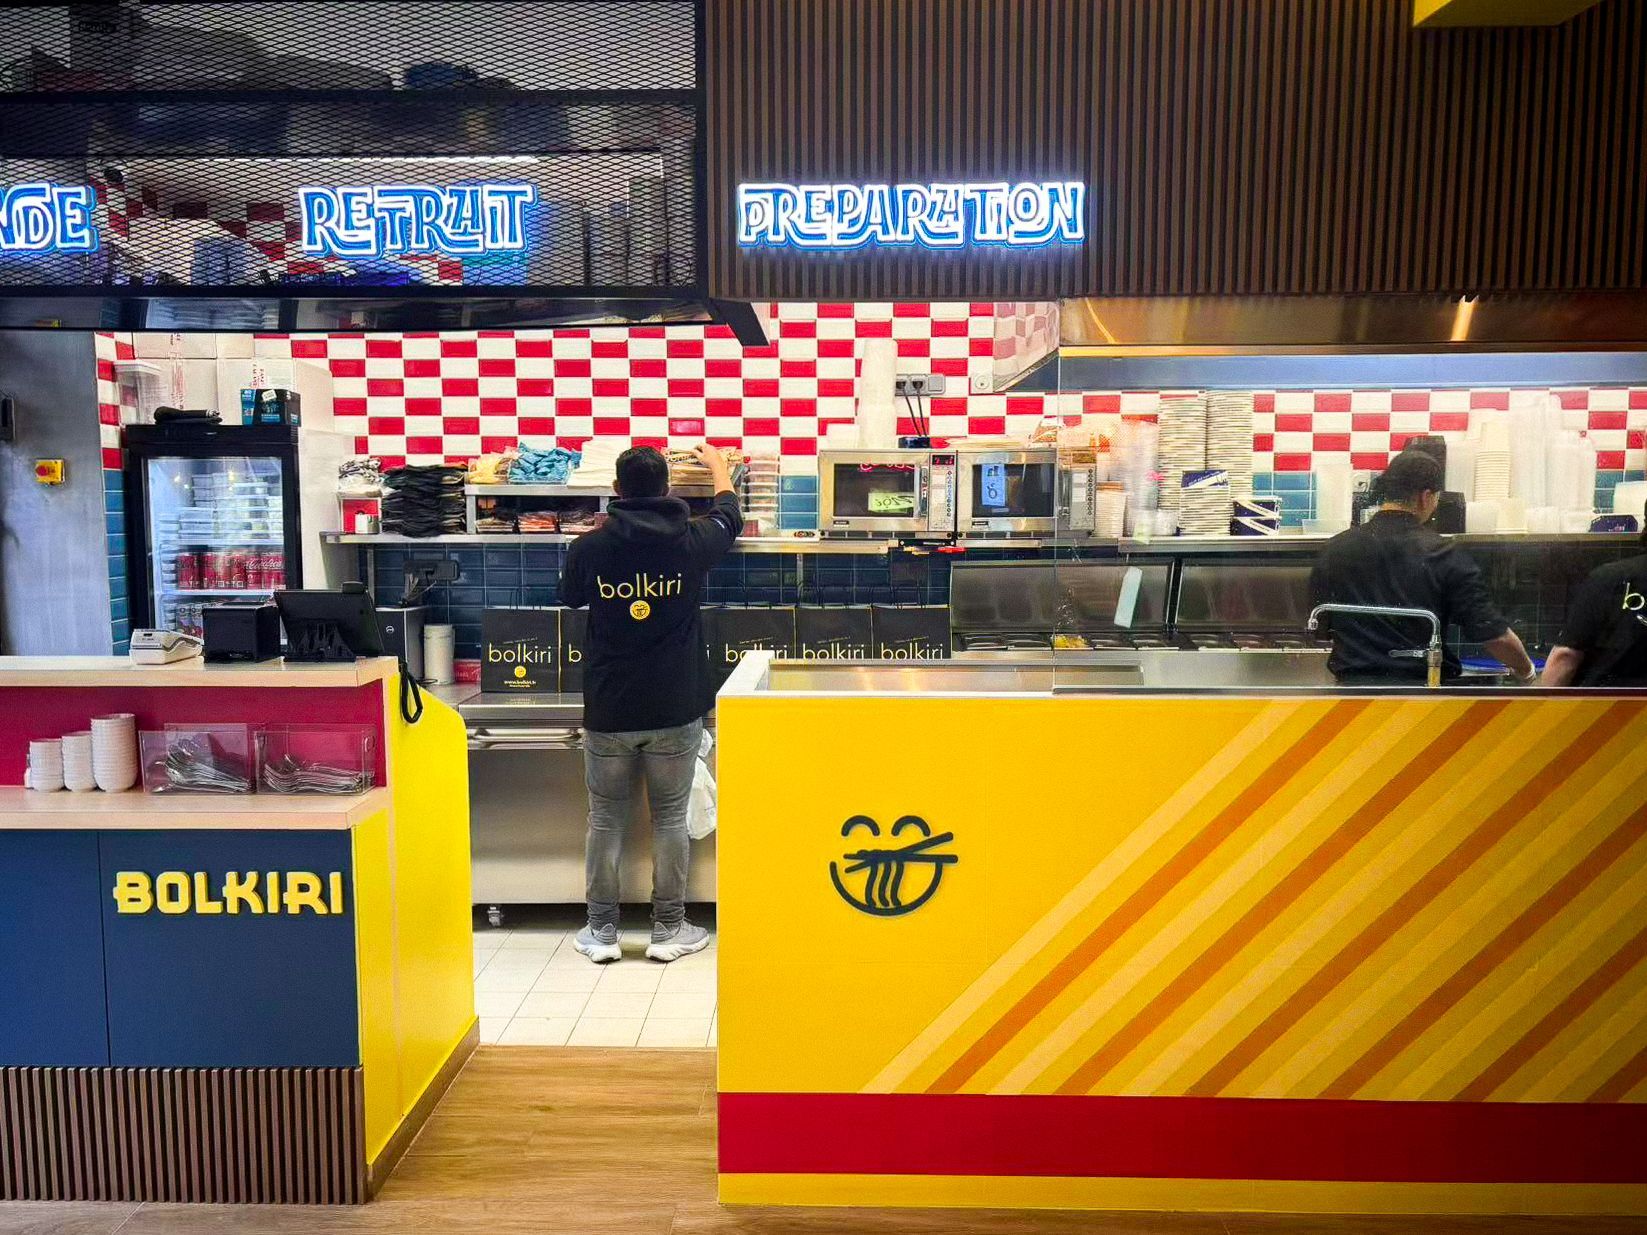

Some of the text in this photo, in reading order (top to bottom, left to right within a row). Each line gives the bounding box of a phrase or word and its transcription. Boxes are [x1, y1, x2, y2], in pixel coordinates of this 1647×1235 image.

[298, 184, 535, 257] RETRAIT
[738, 182, 1085, 247] PREPARATION
[596, 573, 682, 599] bolkiri
[488, 643, 552, 664] bolkiri
[113, 871, 343, 915] BOLKIRI
